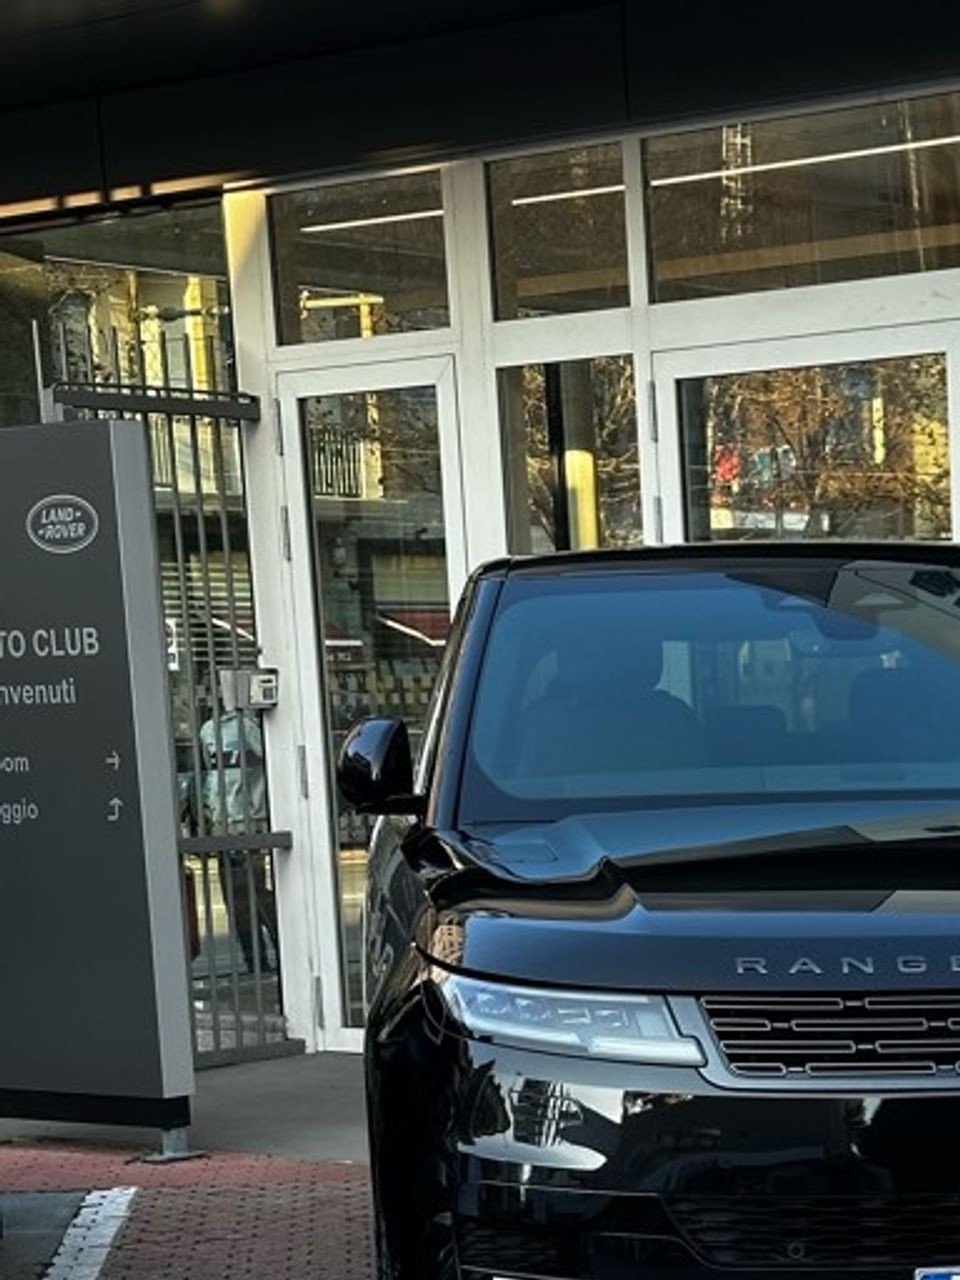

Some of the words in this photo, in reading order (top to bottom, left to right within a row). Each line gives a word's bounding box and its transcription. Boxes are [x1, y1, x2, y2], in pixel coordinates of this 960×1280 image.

[32, 627, 100, 657] CLUB
[0, 757, 29, 772] om
[0, 797, 39, 824] ggio
